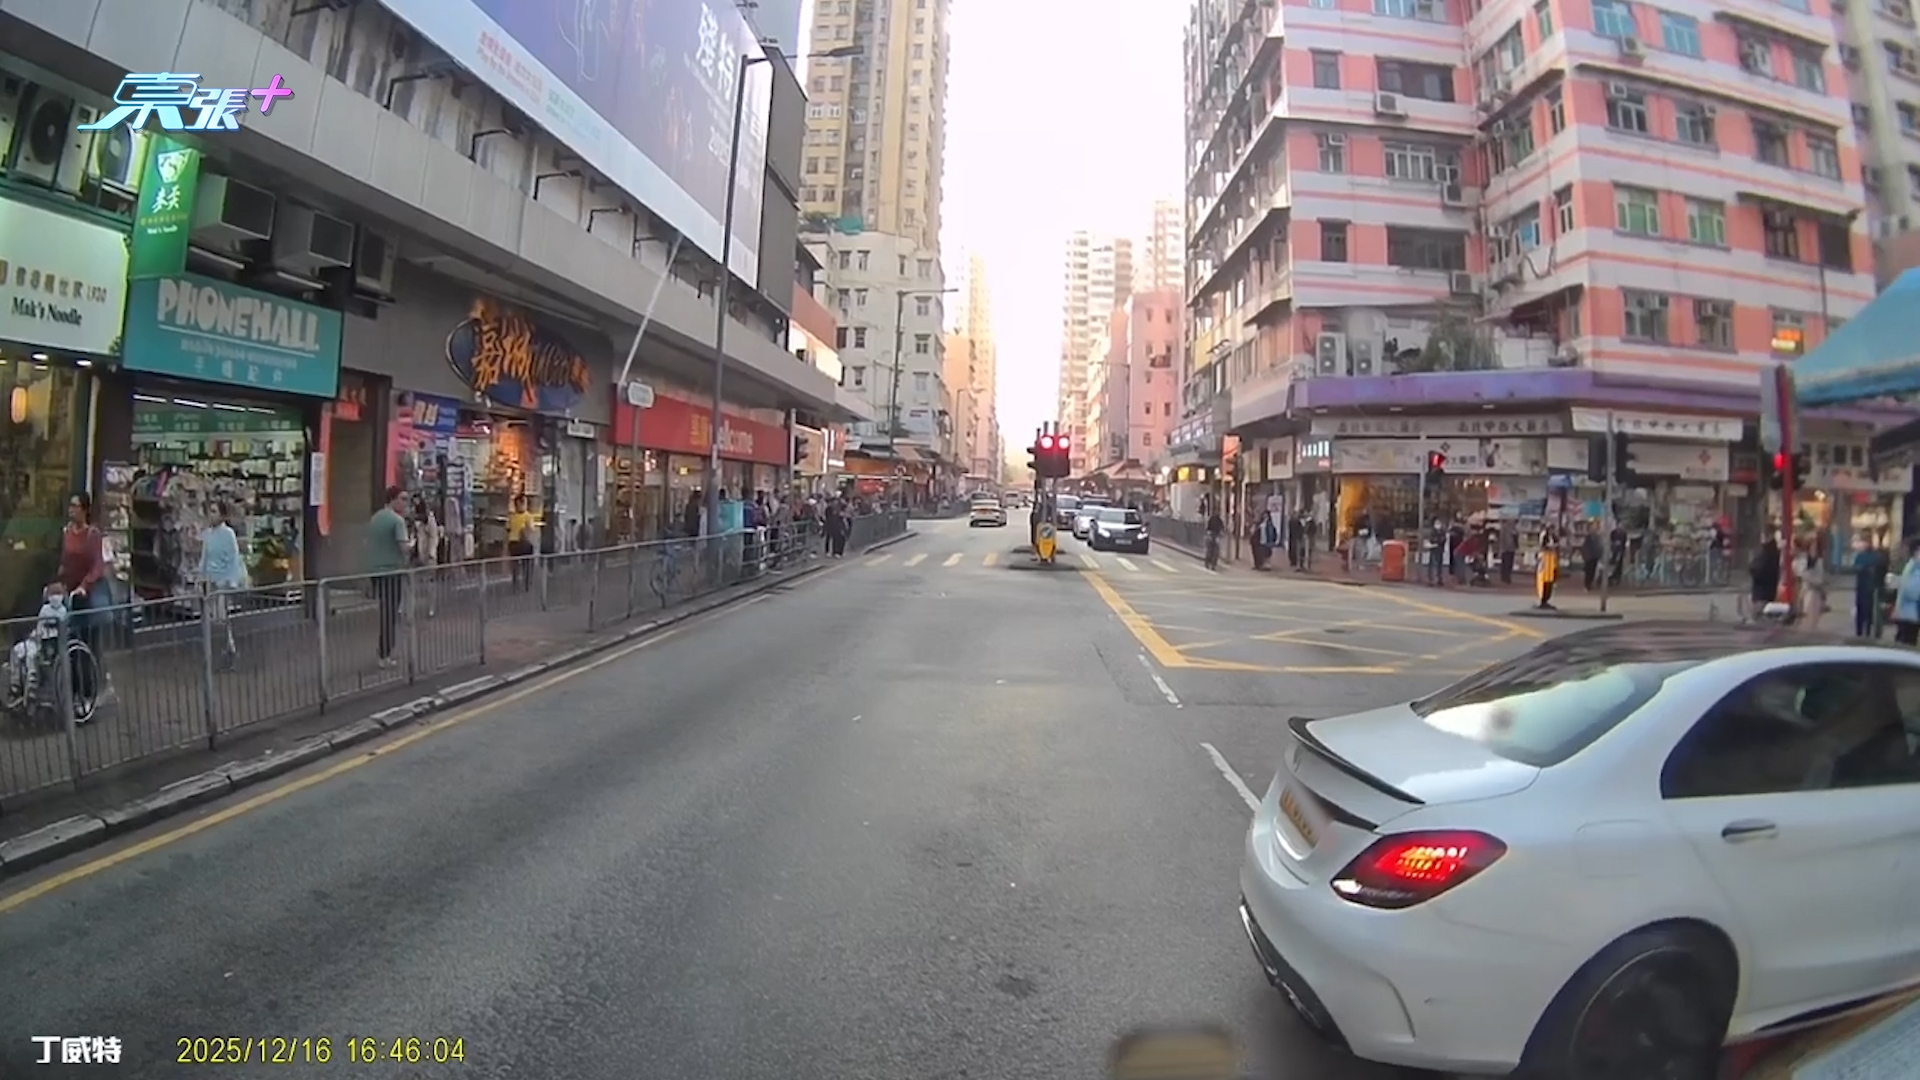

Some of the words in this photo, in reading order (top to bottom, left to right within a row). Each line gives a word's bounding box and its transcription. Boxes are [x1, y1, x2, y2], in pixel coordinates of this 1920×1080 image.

[11, 296, 45, 319] Mak's
[46, 302, 82, 326] Noodle
[157, 277, 321, 353] PHONEHALL
